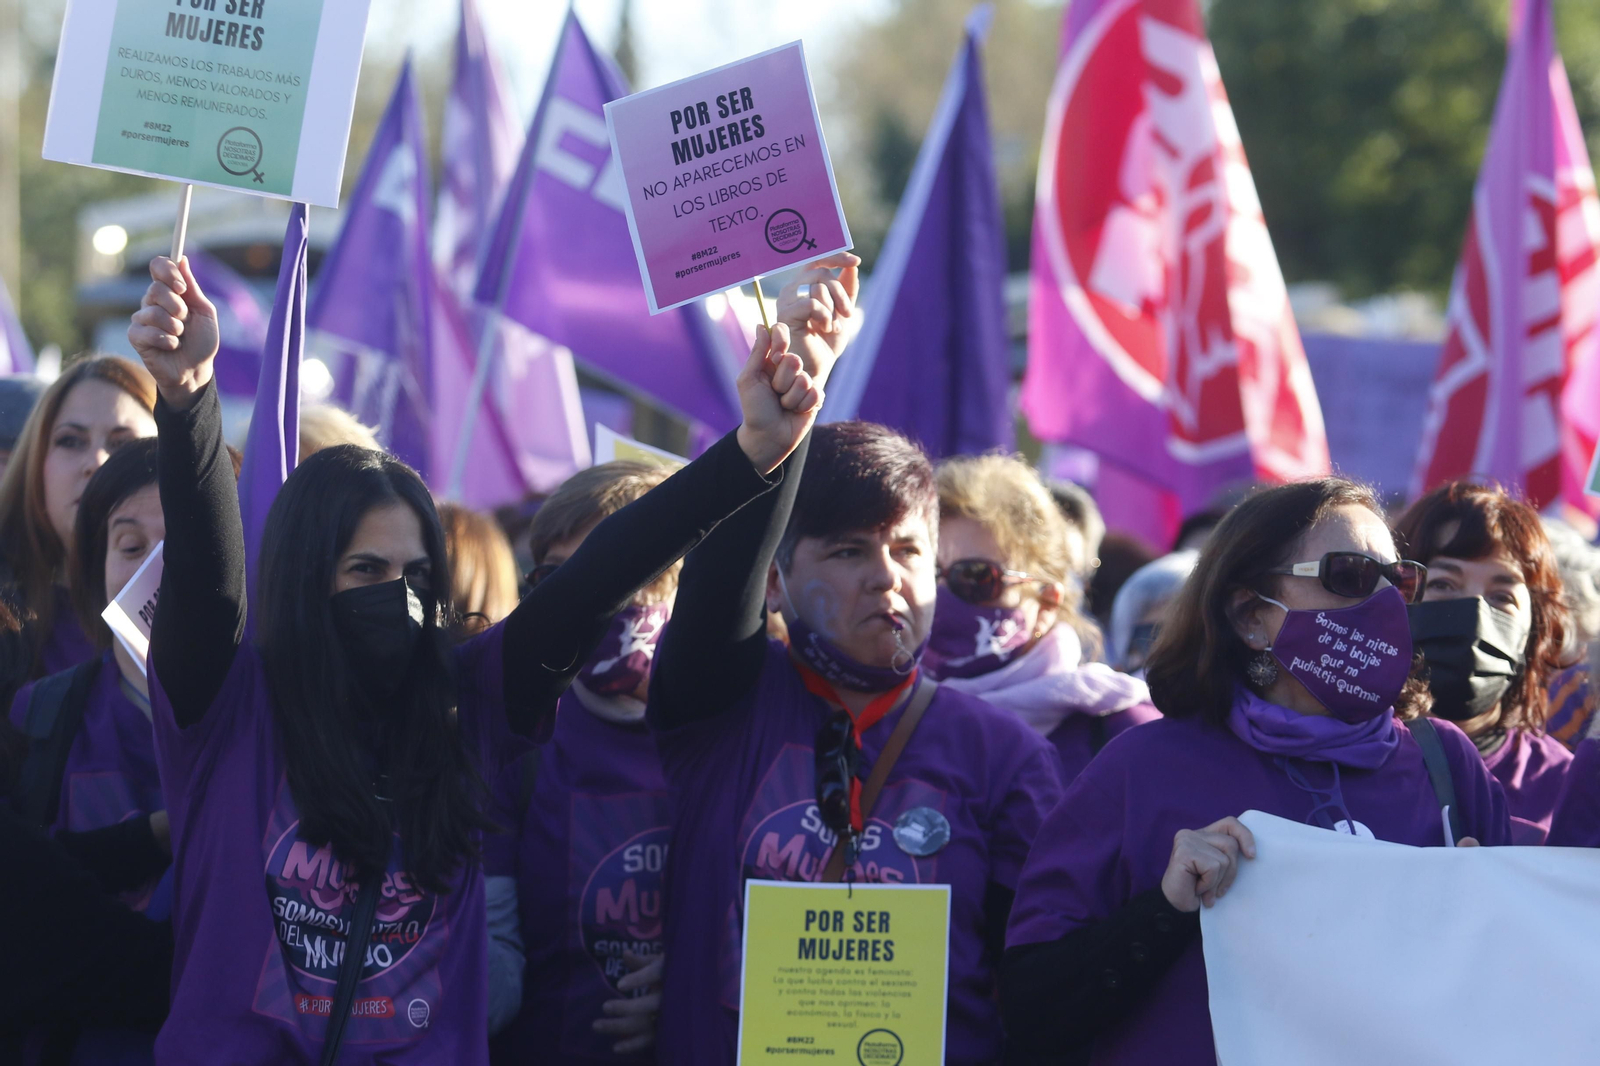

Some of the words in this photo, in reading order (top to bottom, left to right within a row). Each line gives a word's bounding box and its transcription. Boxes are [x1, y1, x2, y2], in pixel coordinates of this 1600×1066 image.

[165, 11, 265, 51] MUJERES
[118, 47, 188, 69] REALIZAMOS
[190, 59, 214, 73] LOS
[217, 63, 272, 83] TRABAJOS
[275, 71, 301, 87] MÁS
[120, 67, 163, 85] DUROS,
[166, 75, 207, 91] MENOS
[210, 82, 281, 102] VALORADOS
[283, 93, 292, 104] Y
[136, 89, 178, 106] MENOS
[180, 95, 268, 120] REMUNERADOS.
[670, 101, 710, 134] POR
[716, 86, 754, 119] SER
[121, 129, 190, 148] #porsermujeres
[144, 121, 172, 133] #8M22
[671, 114, 765, 166] MUJERES
[224, 146, 256, 156] NOSOTRAS
[225, 139, 257, 150] Plataforma
[643, 181, 668, 200] NO
[673, 142, 782, 191] APARECEMOS
[786, 134, 806, 153] EN
[673, 195, 705, 218] LOS
[708, 176, 762, 206] LIBROS
[767, 168, 788, 187] DE
[709, 206, 764, 233] TEXTO.
[770, 219, 799, 232] Plataforma
[771, 224, 801, 238] NOSOTRAS
[772, 229, 802, 243] DECIDIMOS
[675, 250, 741, 279] #porsermujeres
[691, 246, 719, 261] #8M22
[1315, 612, 1348, 635] Somos
[1350, 628, 1365, 642] las
[1366, 638, 1398, 656] nietas
[1318, 631, 1332, 645] de
[1332, 638, 1348, 652] las
[1350, 645, 1381, 669] brujas
[1290, 656, 1336, 684] pudisteis
[1344, 665, 1359, 677] no
[273, 896, 338, 930] SOMOS
[805, 910, 844, 933] POR
[853, 911, 890, 933] SER
[279, 921, 304, 947] DEL
[304, 934, 392, 969] MUO
[798, 938, 895, 962] MUJERES
[766, 1046, 835, 1056] #porsermujeres
